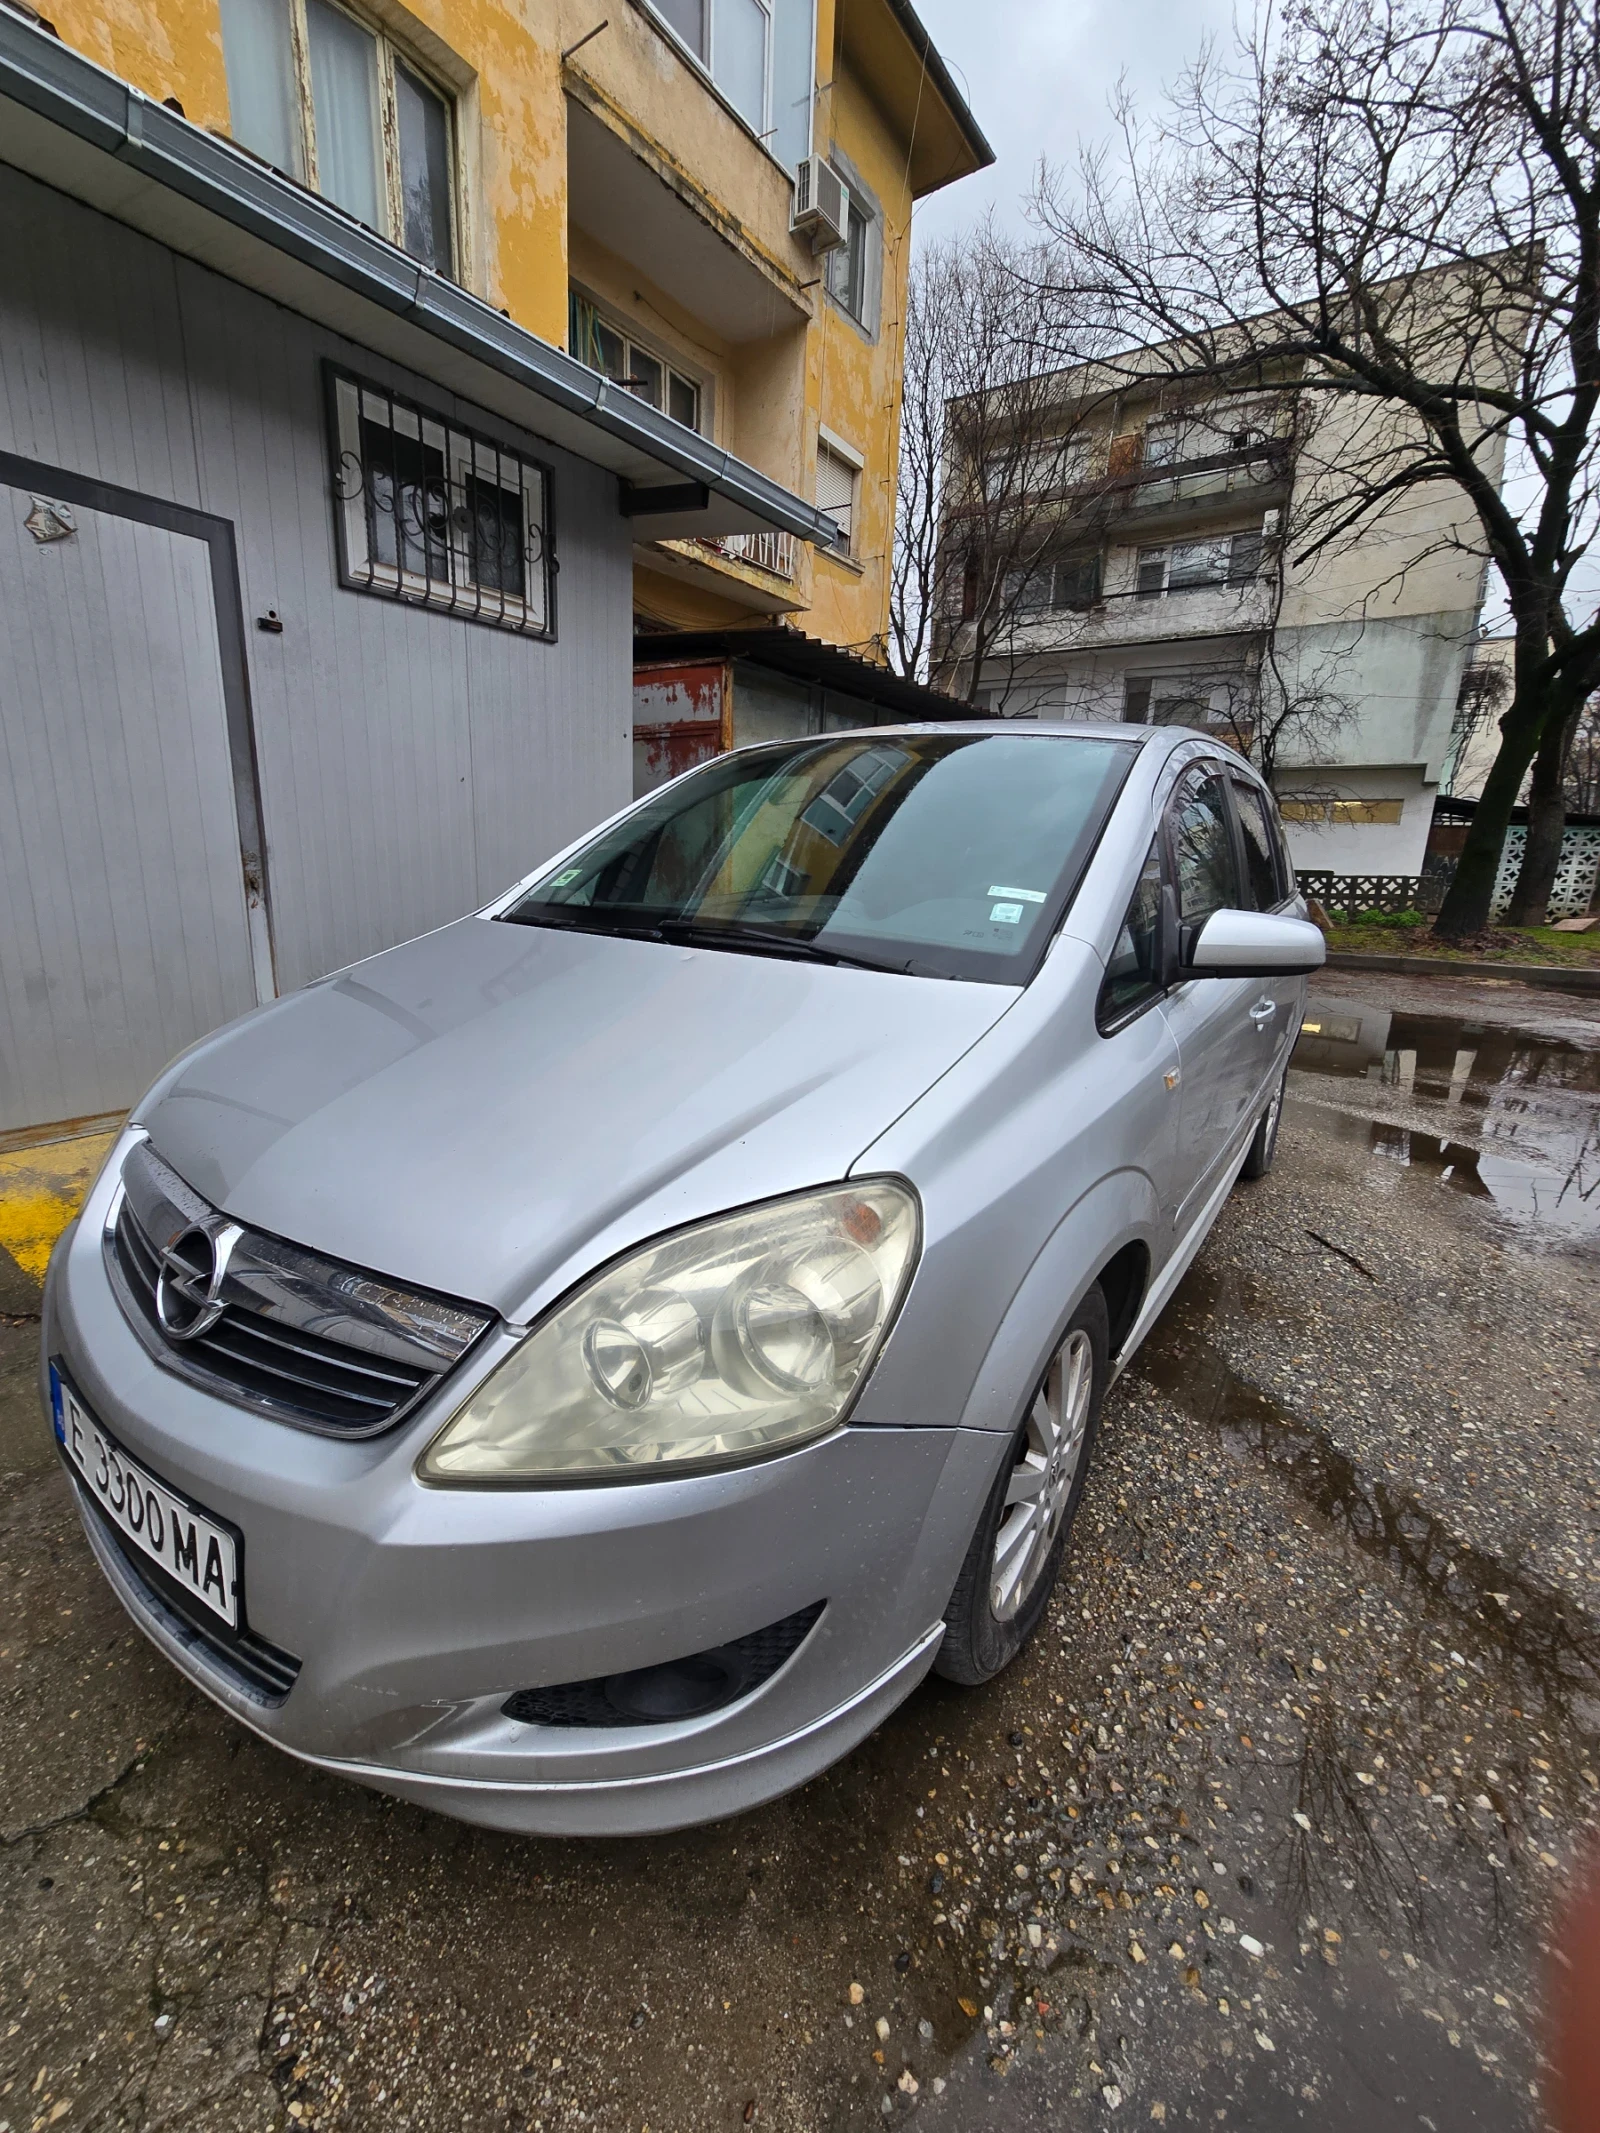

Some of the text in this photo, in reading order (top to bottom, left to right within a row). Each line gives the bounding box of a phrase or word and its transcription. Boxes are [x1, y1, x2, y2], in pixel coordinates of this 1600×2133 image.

[69, 1398, 227, 1609] E 3300 MA
